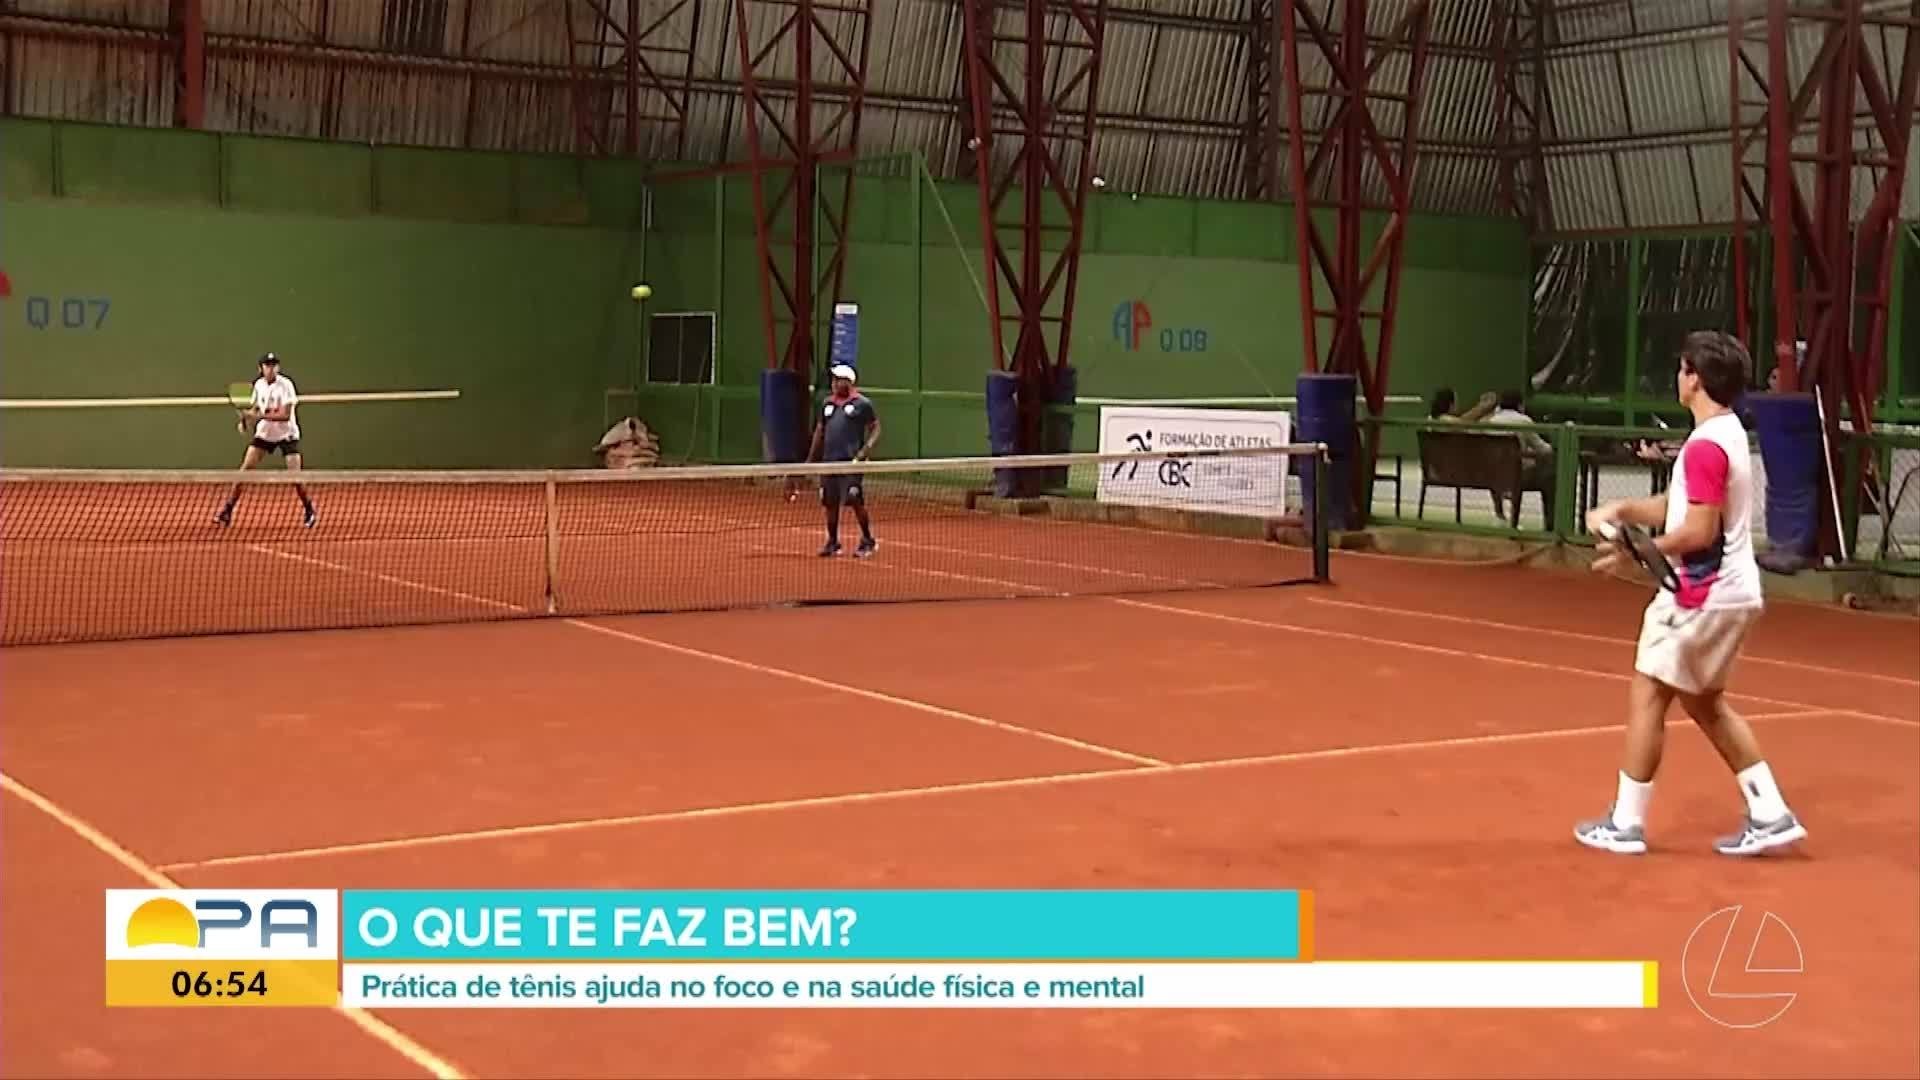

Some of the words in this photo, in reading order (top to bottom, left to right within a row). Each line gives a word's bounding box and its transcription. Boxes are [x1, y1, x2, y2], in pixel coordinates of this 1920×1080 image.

[26, 296, 49, 331] Q
[63, 298, 111, 330] 07
[1180, 328, 1207, 352] 08
[1159, 431, 1213, 447] FORMAÇÃO
[1214, 434, 1227, 448] DE
